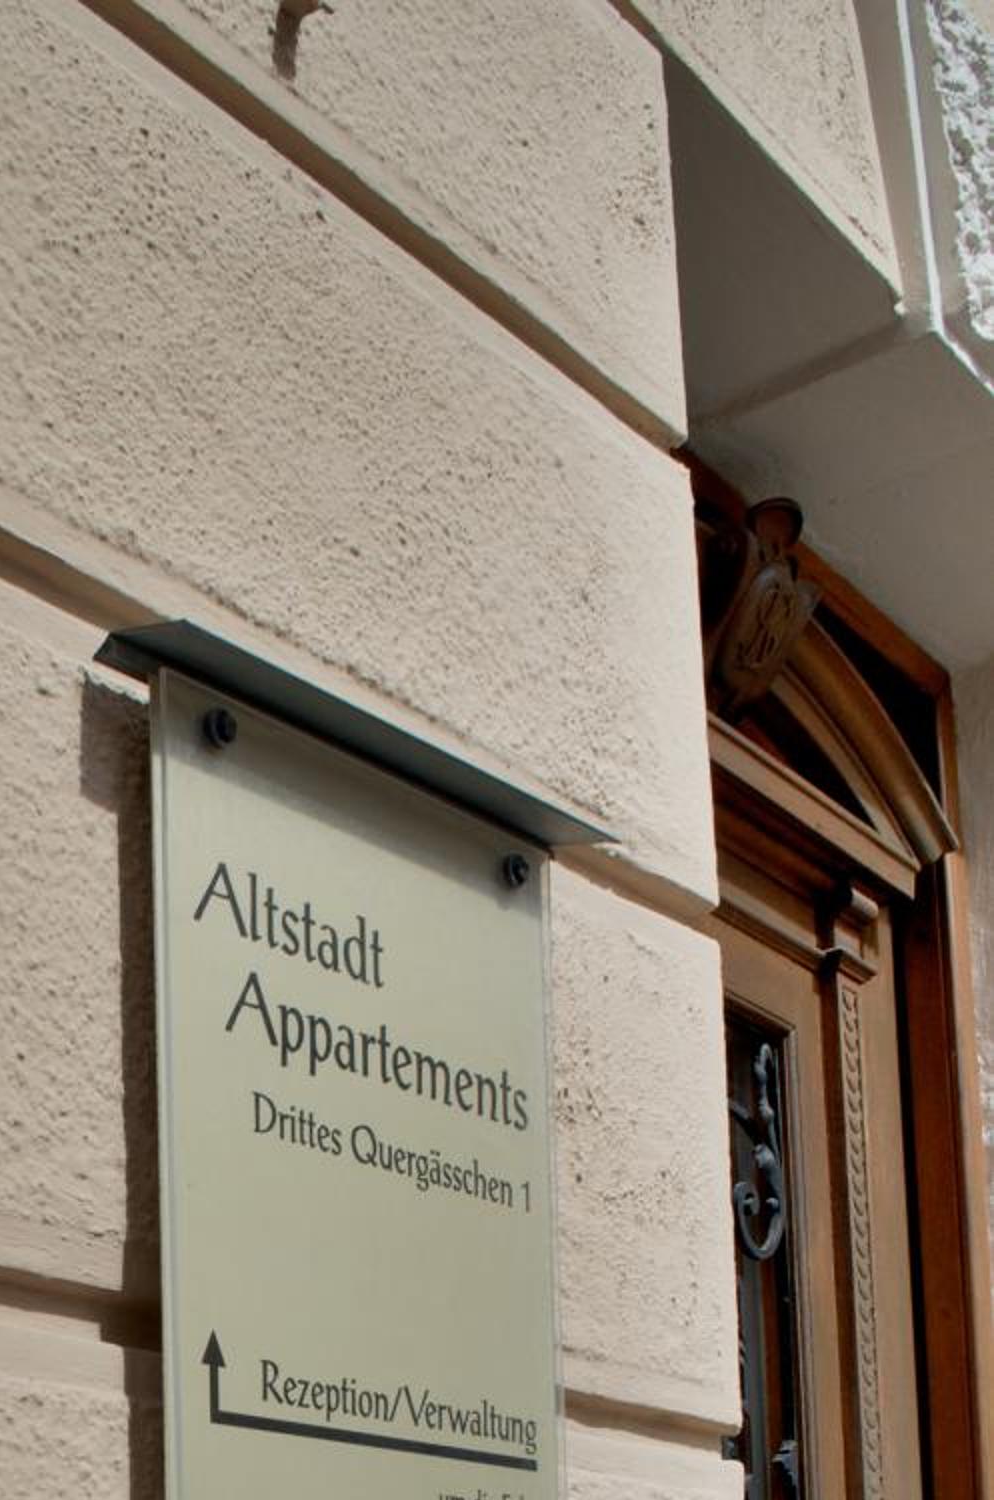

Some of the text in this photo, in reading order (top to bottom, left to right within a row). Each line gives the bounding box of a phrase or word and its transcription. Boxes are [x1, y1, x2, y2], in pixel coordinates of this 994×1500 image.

[193, 862, 384, 988] Altstadt
[225, 972, 528, 1131] Appartements
[252, 1091, 531, 1212] Drittes Quergässchen 1
[261, 1359, 538, 1455] Rezeption/Verwaltung
